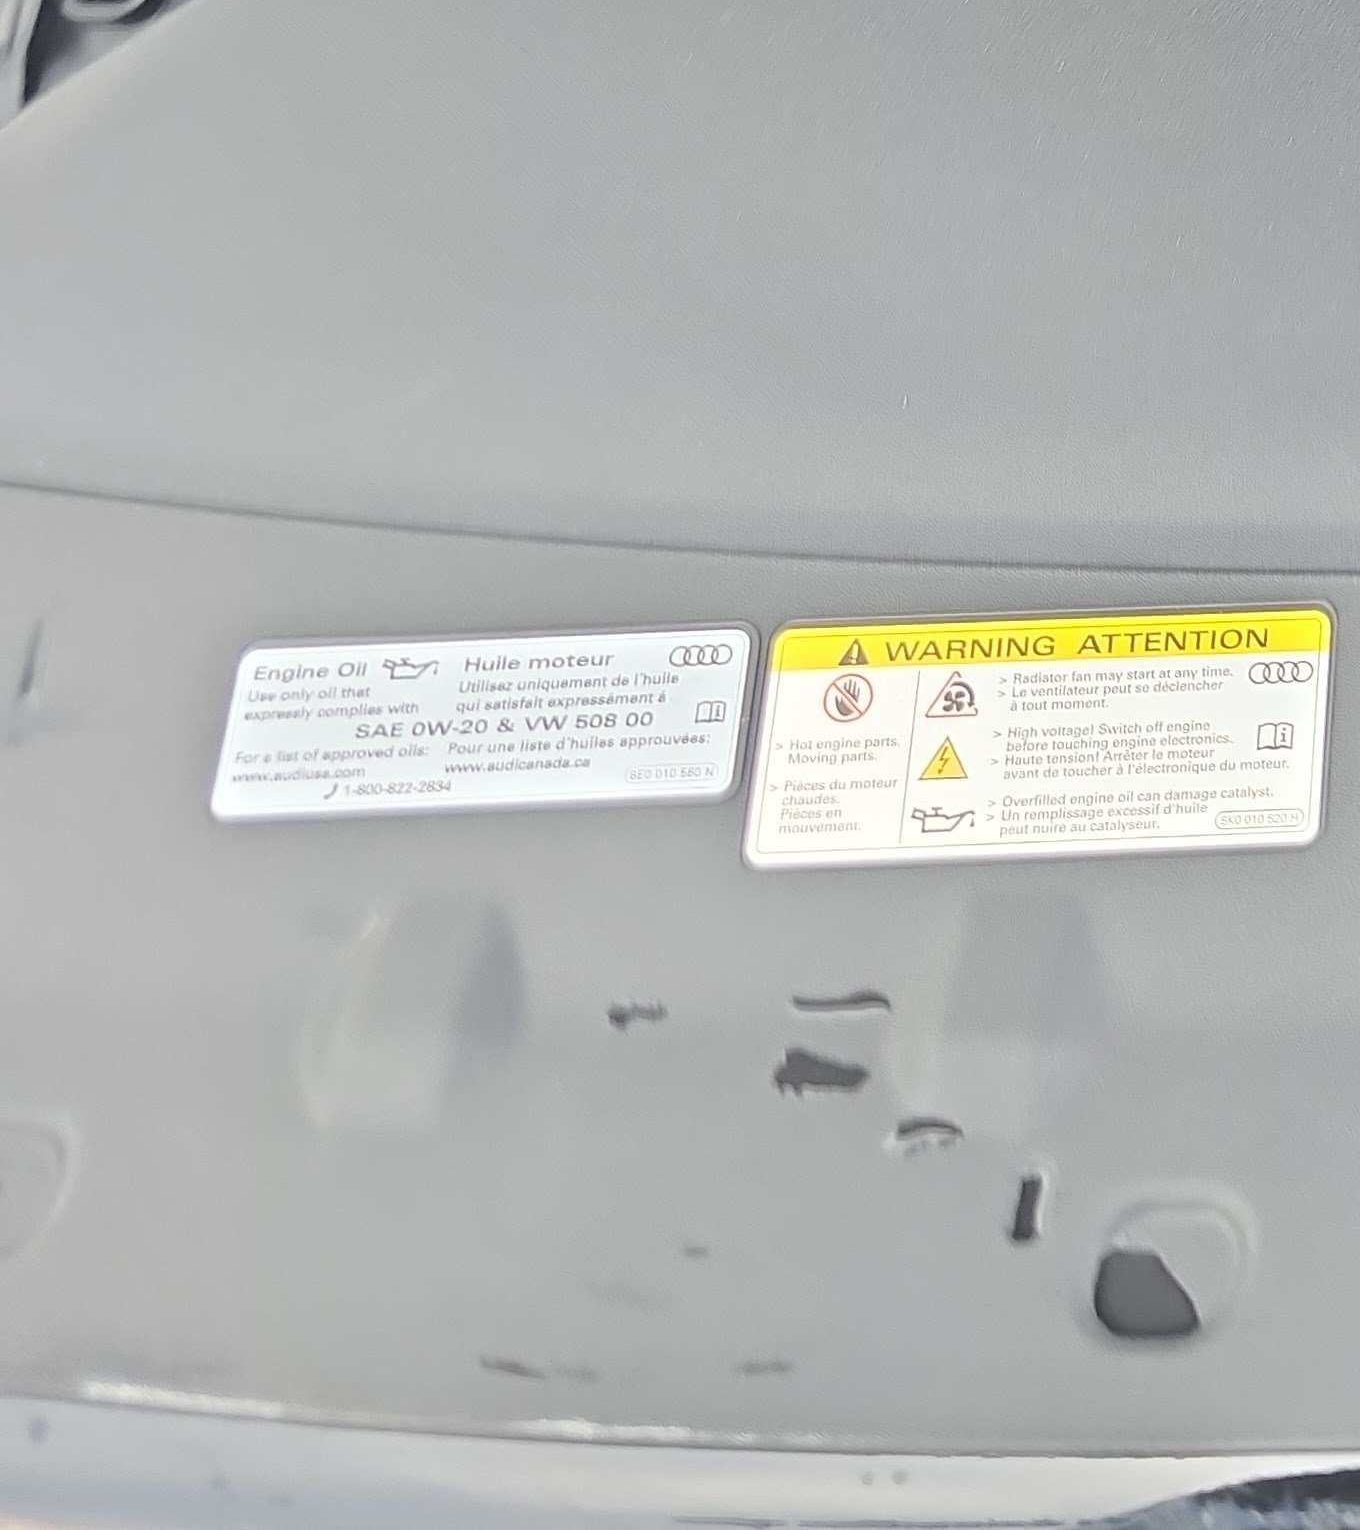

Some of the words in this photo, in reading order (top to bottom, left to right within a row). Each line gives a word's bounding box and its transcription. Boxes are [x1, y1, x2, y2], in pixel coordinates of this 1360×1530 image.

[885, 635, 1055, 661] WARNING
[1076, 628, 1268, 654] ATTENTION
[253, 663, 329, 683] Engine
[337, 661, 367, 677] Oil
[464, 655, 520, 672] Huile
[528, 654, 614, 669] moteur
[458, 679, 513, 693] Utilisez
[516, 676, 607, 691] uniquement
[610, 673, 629, 686] de
[1013, 671, 1067, 684] Radiator
[1071, 670, 1091, 682] fan
[1095, 671, 1123, 682] may
[1125, 669, 1155, 680] start
[1158, 669, 1170, 678] at
[1174, 669, 1198, 679] any
[1201, 665, 1233, 677] time.
[247, 689, 276, 702] Use
[279, 687, 314, 701] only
[317, 686, 337, 699] oil
[340, 685, 370, 699] that
[1011, 686, 1027, 697] Le
[1030, 684, 1099, 697] ventilateur
[1102, 683, 1131, 696] peut
[1134, 684, 1149, 693] se
[1152, 678, 1223, 692] déclencher
[243, 706, 313, 721] expressly
[316, 702, 383, 718] complies
[387, 701, 419, 714] with
[455, 698, 480, 714] qui
[483, 695, 543, 710] satisfait
[547, 692, 653, 708] expressément
[1021, 700, 1047, 711] tout
[1050, 698, 1108, 710] moment.
[354, 721, 403, 739] SAE
[411, 718, 488, 736] 0W-20
[496, 717, 514, 733] &
[524, 714, 568, 731] VW
[574, 712, 617, 729] 508
[625, 711, 653, 727] 00
[1007, 726, 1037, 741] High
[1041, 723, 1094, 738] voltage!
[1097, 722, 1141, 735] Switch
[1145, 720, 1163, 733] off
[1166, 719, 1210, 733] engine
[447, 741, 483, 754] Pour
[486, 742, 515, 753] une
[519, 738, 551, 752] liste
[555, 735, 614, 750] d'huiles
[619, 732, 710, 749] approuvées:
[789, 738, 812, 750] Hot
[815, 736, 861, 751] engine
[864, 737, 900, 749] parts.
[1006, 740, 1048, 752] before
[1051, 737, 1108, 750] touching
[1112, 735, 1156, 749] engine
[1159, 732, 1233, 746] electronics.
[235, 751, 259, 764] For
[262, 753, 272, 763] a
[275, 749, 298, 762] list
[301, 747, 319, 761] of
[321, 744, 394, 762] approved
[397, 743, 429, 757] oils:
[787, 750, 837, 765] Moving
[840, 751, 877, 765] parts.
[1004, 754, 1043, 766] Haute
[1046, 750, 1099, 764] tension!
[1102, 749, 1149, 762] Arrêter
[1151, 748, 1163, 760] le
[1167, 748, 1215, 759] moteur
[444, 755, 590, 773] www.audicanada.ca
[655, 767, 677, 778] 010
[1002, 768, 1038, 779] avant
[1042, 766, 1059, 778] de
[1062, 764, 1112, 777] toucher
[1127, 760, 1216, 775] l'électronique
[1219, 759, 1235, 771] du
[1239, 759, 1289, 770] moteur.
[232, 767, 365, 782] www.audiusa.com
[344, 779, 451, 796] 1-800-822-2834
[783, 779, 825, 791] Pièces
[828, 778, 846, 790] du
[849, 778, 898, 789] moteur
[781, 792, 840, 805] chaudes.
[1002, 793, 1066, 807] Overfilled
[1069, 791, 1114, 806] engine
[1117, 790, 1133, 802] oil
[1137, 792, 1160, 801] can
[1163, 788, 1217, 801] damage
[1220, 785, 1273, 799] catalyst.
[780, 807, 822, 820] Pièces
[825, 808, 842, 818] en
[1001, 809, 1019, 821] Un
[1024, 807, 1103, 822] remplissage
[1107, 802, 1160, 817] excessif
[1162, 799, 1207, 814] d'huile
[1243, 813, 1264, 824] 010
[778, 821, 861, 834] mouvement.
[999, 824, 1028, 838] peut
[1032, 822, 1066, 833] nuire
[1069, 823, 1085, 832] au
[1089, 819, 1160, 832] catalyseur.
